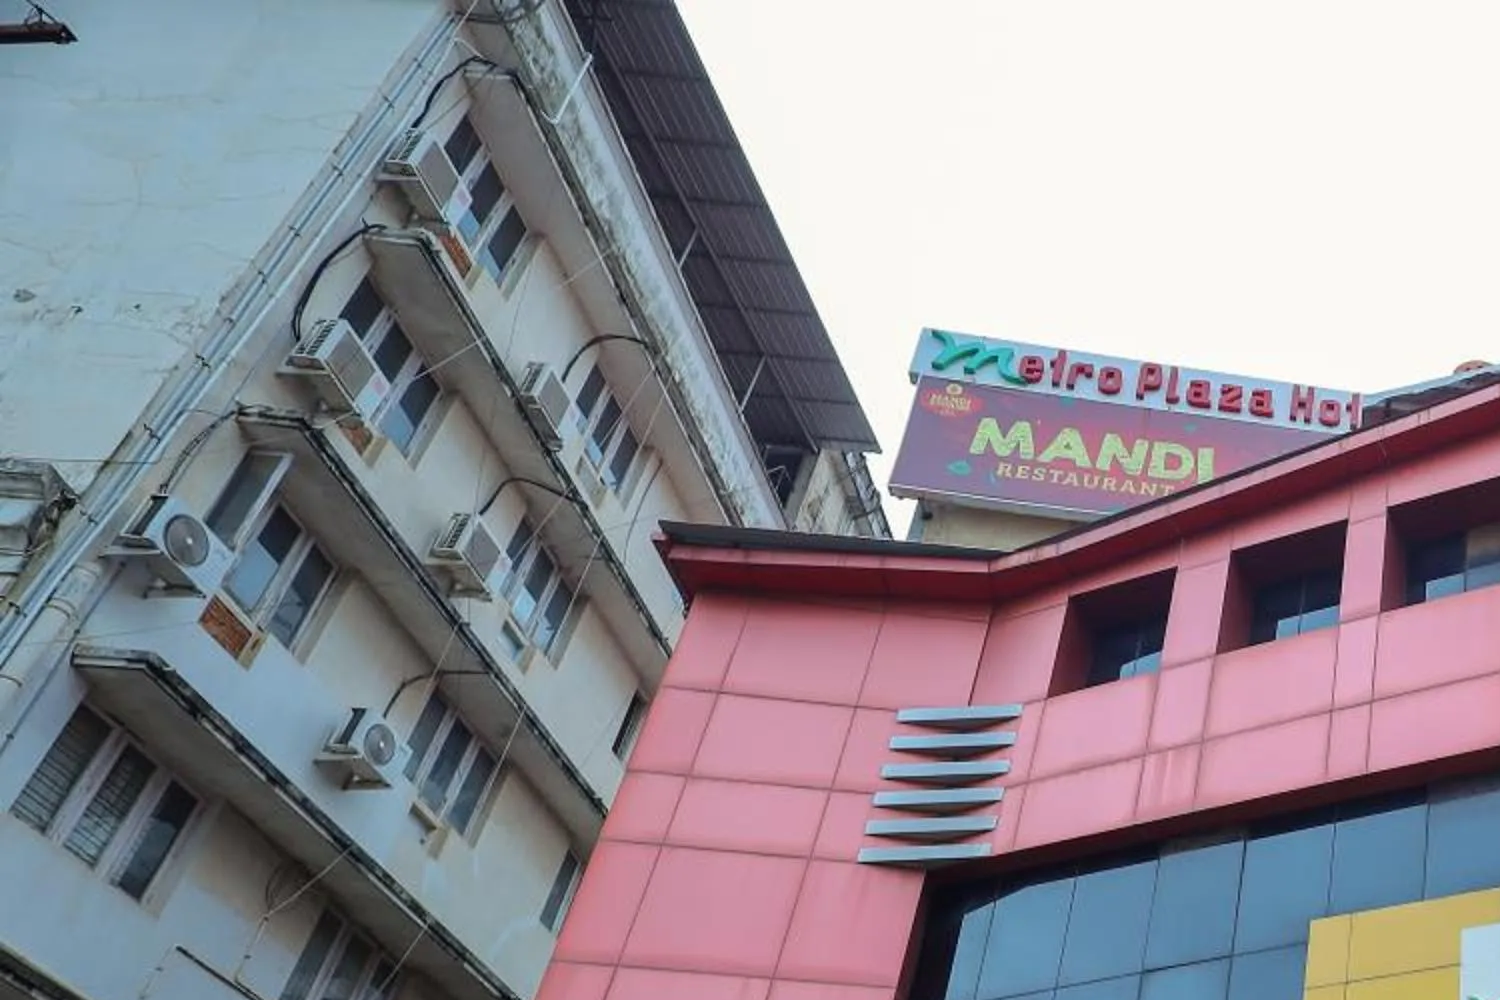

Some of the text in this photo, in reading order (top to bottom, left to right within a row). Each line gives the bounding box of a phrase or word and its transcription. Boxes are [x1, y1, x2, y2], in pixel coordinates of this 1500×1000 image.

[1136, 361, 1274, 419] Plaza
[1290, 383, 1362, 431] Hot
[967, 417, 1216, 485] MANDI
[996, 461, 1176, 498] RESTAURANT
